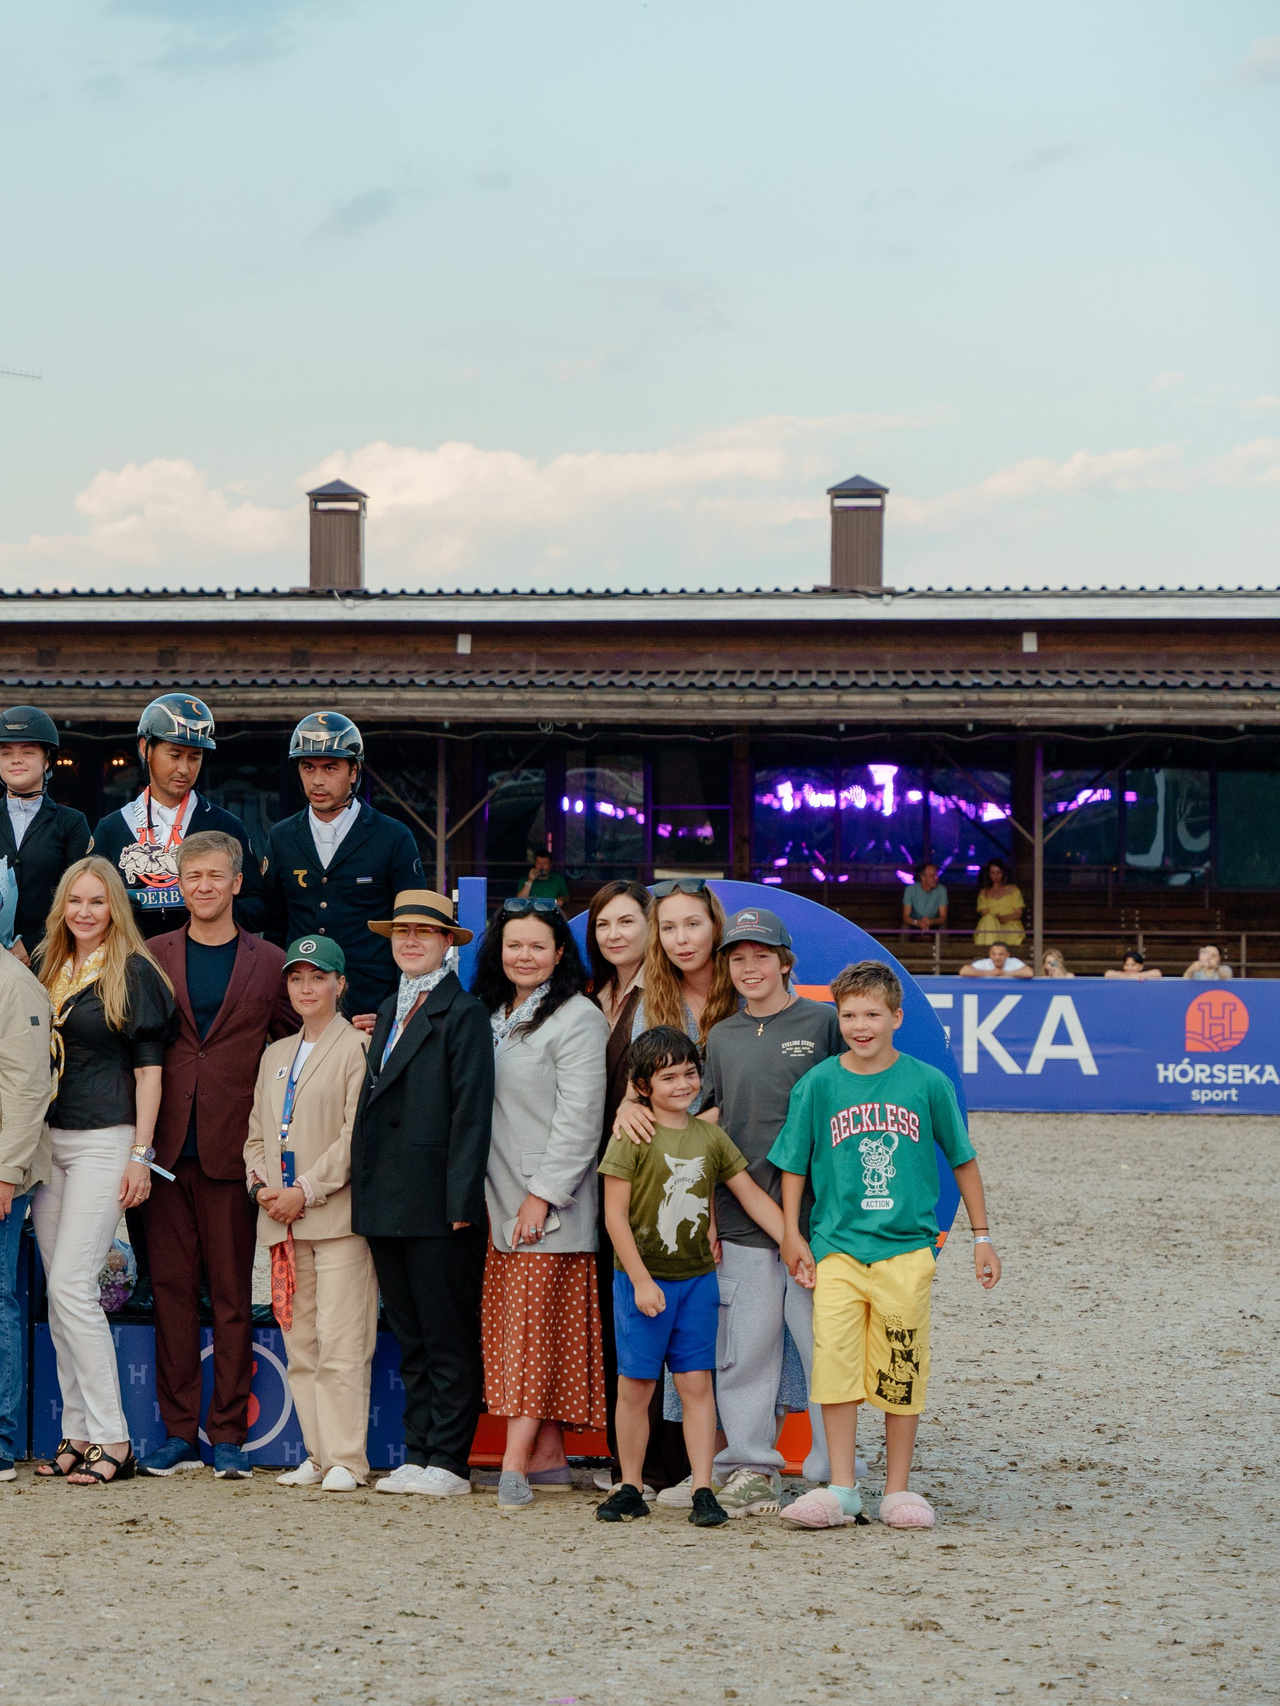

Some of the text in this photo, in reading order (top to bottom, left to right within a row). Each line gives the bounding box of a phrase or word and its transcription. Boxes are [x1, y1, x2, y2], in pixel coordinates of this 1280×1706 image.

[136, 889, 186, 905] DERB
[1156, 1057, 1280, 1085] HÓRSEKA
[1191, 1087, 1238, 1104] sport
[830, 1103, 919, 1149] RECKLESS
[865, 1200, 890, 1208] ACTION
